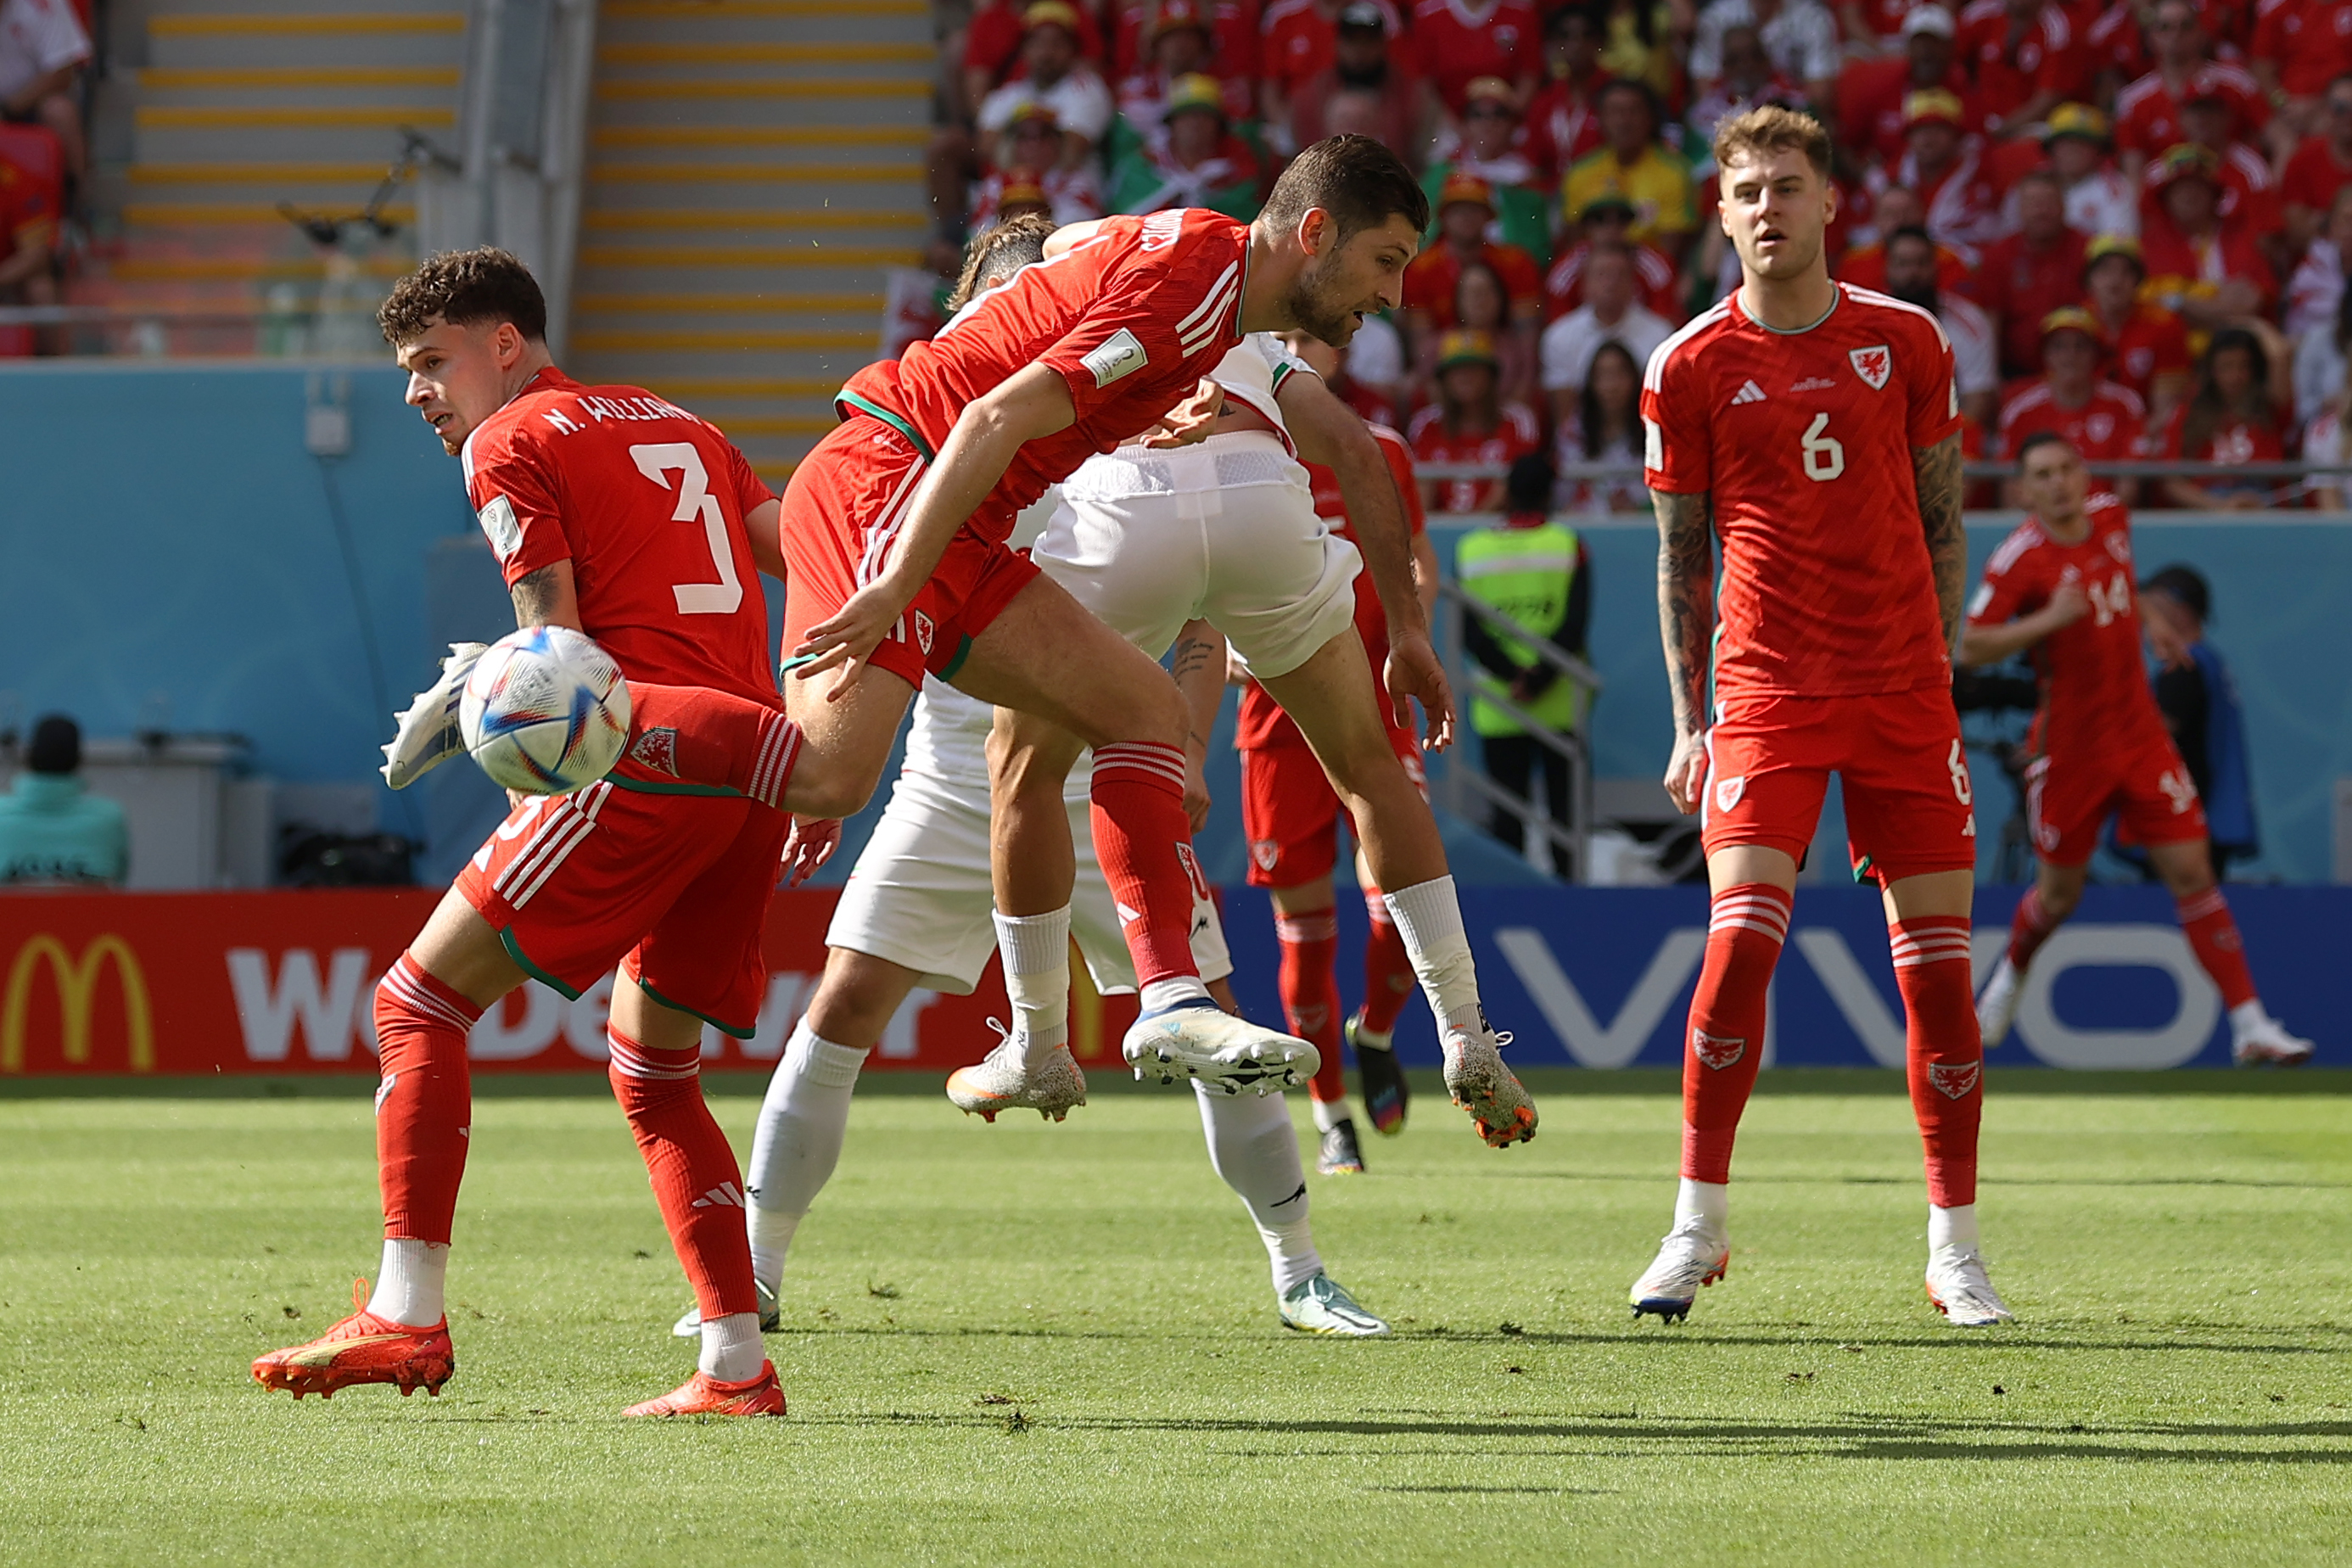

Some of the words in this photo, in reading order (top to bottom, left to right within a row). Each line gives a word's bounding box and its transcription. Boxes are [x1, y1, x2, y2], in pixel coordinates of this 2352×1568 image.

[540, 408, 586, 436] N.
[1800, 412, 1845, 482] 6
[628, 442, 743, 614] 3
[2086, 570, 2131, 627] 14
[1947, 737, 1972, 805] 6
